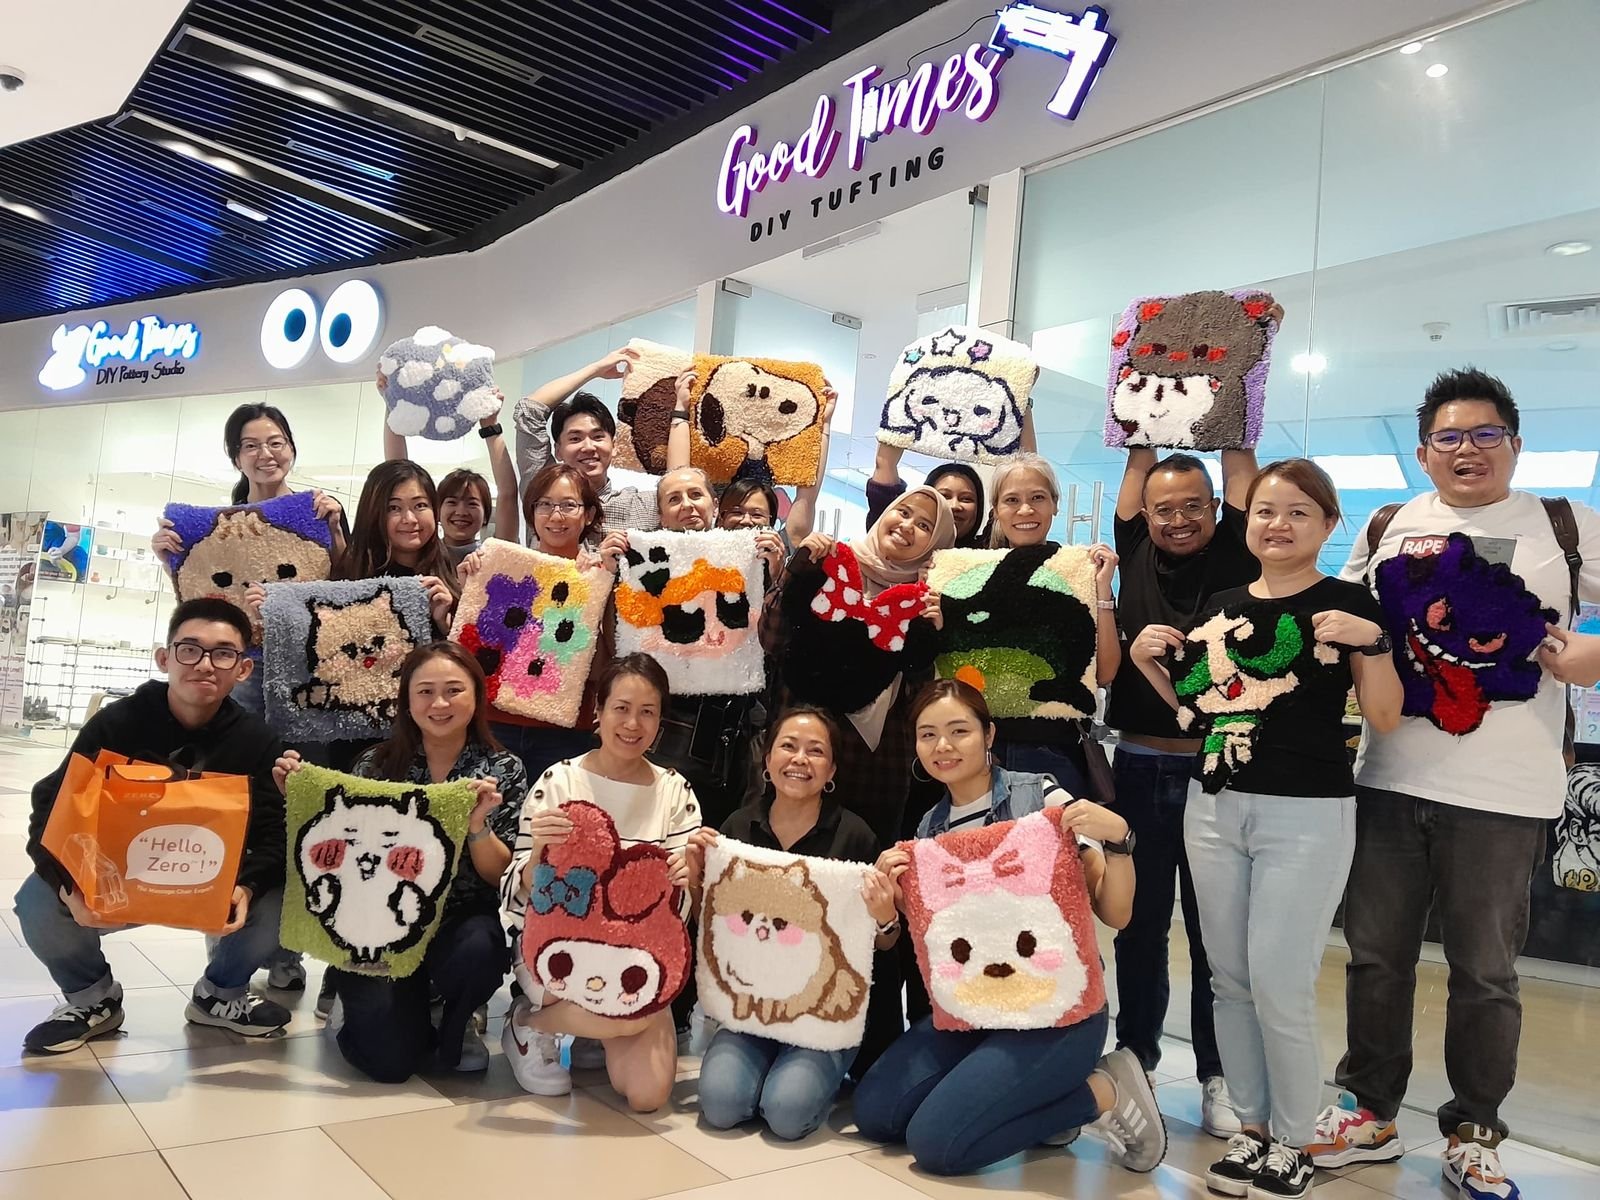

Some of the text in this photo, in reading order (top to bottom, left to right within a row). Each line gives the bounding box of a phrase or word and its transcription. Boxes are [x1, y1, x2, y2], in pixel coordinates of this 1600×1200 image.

[717, 43, 1003, 217] Good Times
[750, 146, 945, 242] DIY TUFTING
[86, 320, 139, 366] Good
[96, 360, 185, 385] DIY Pottery Studio
[1402, 539, 1444, 554] BAPE
